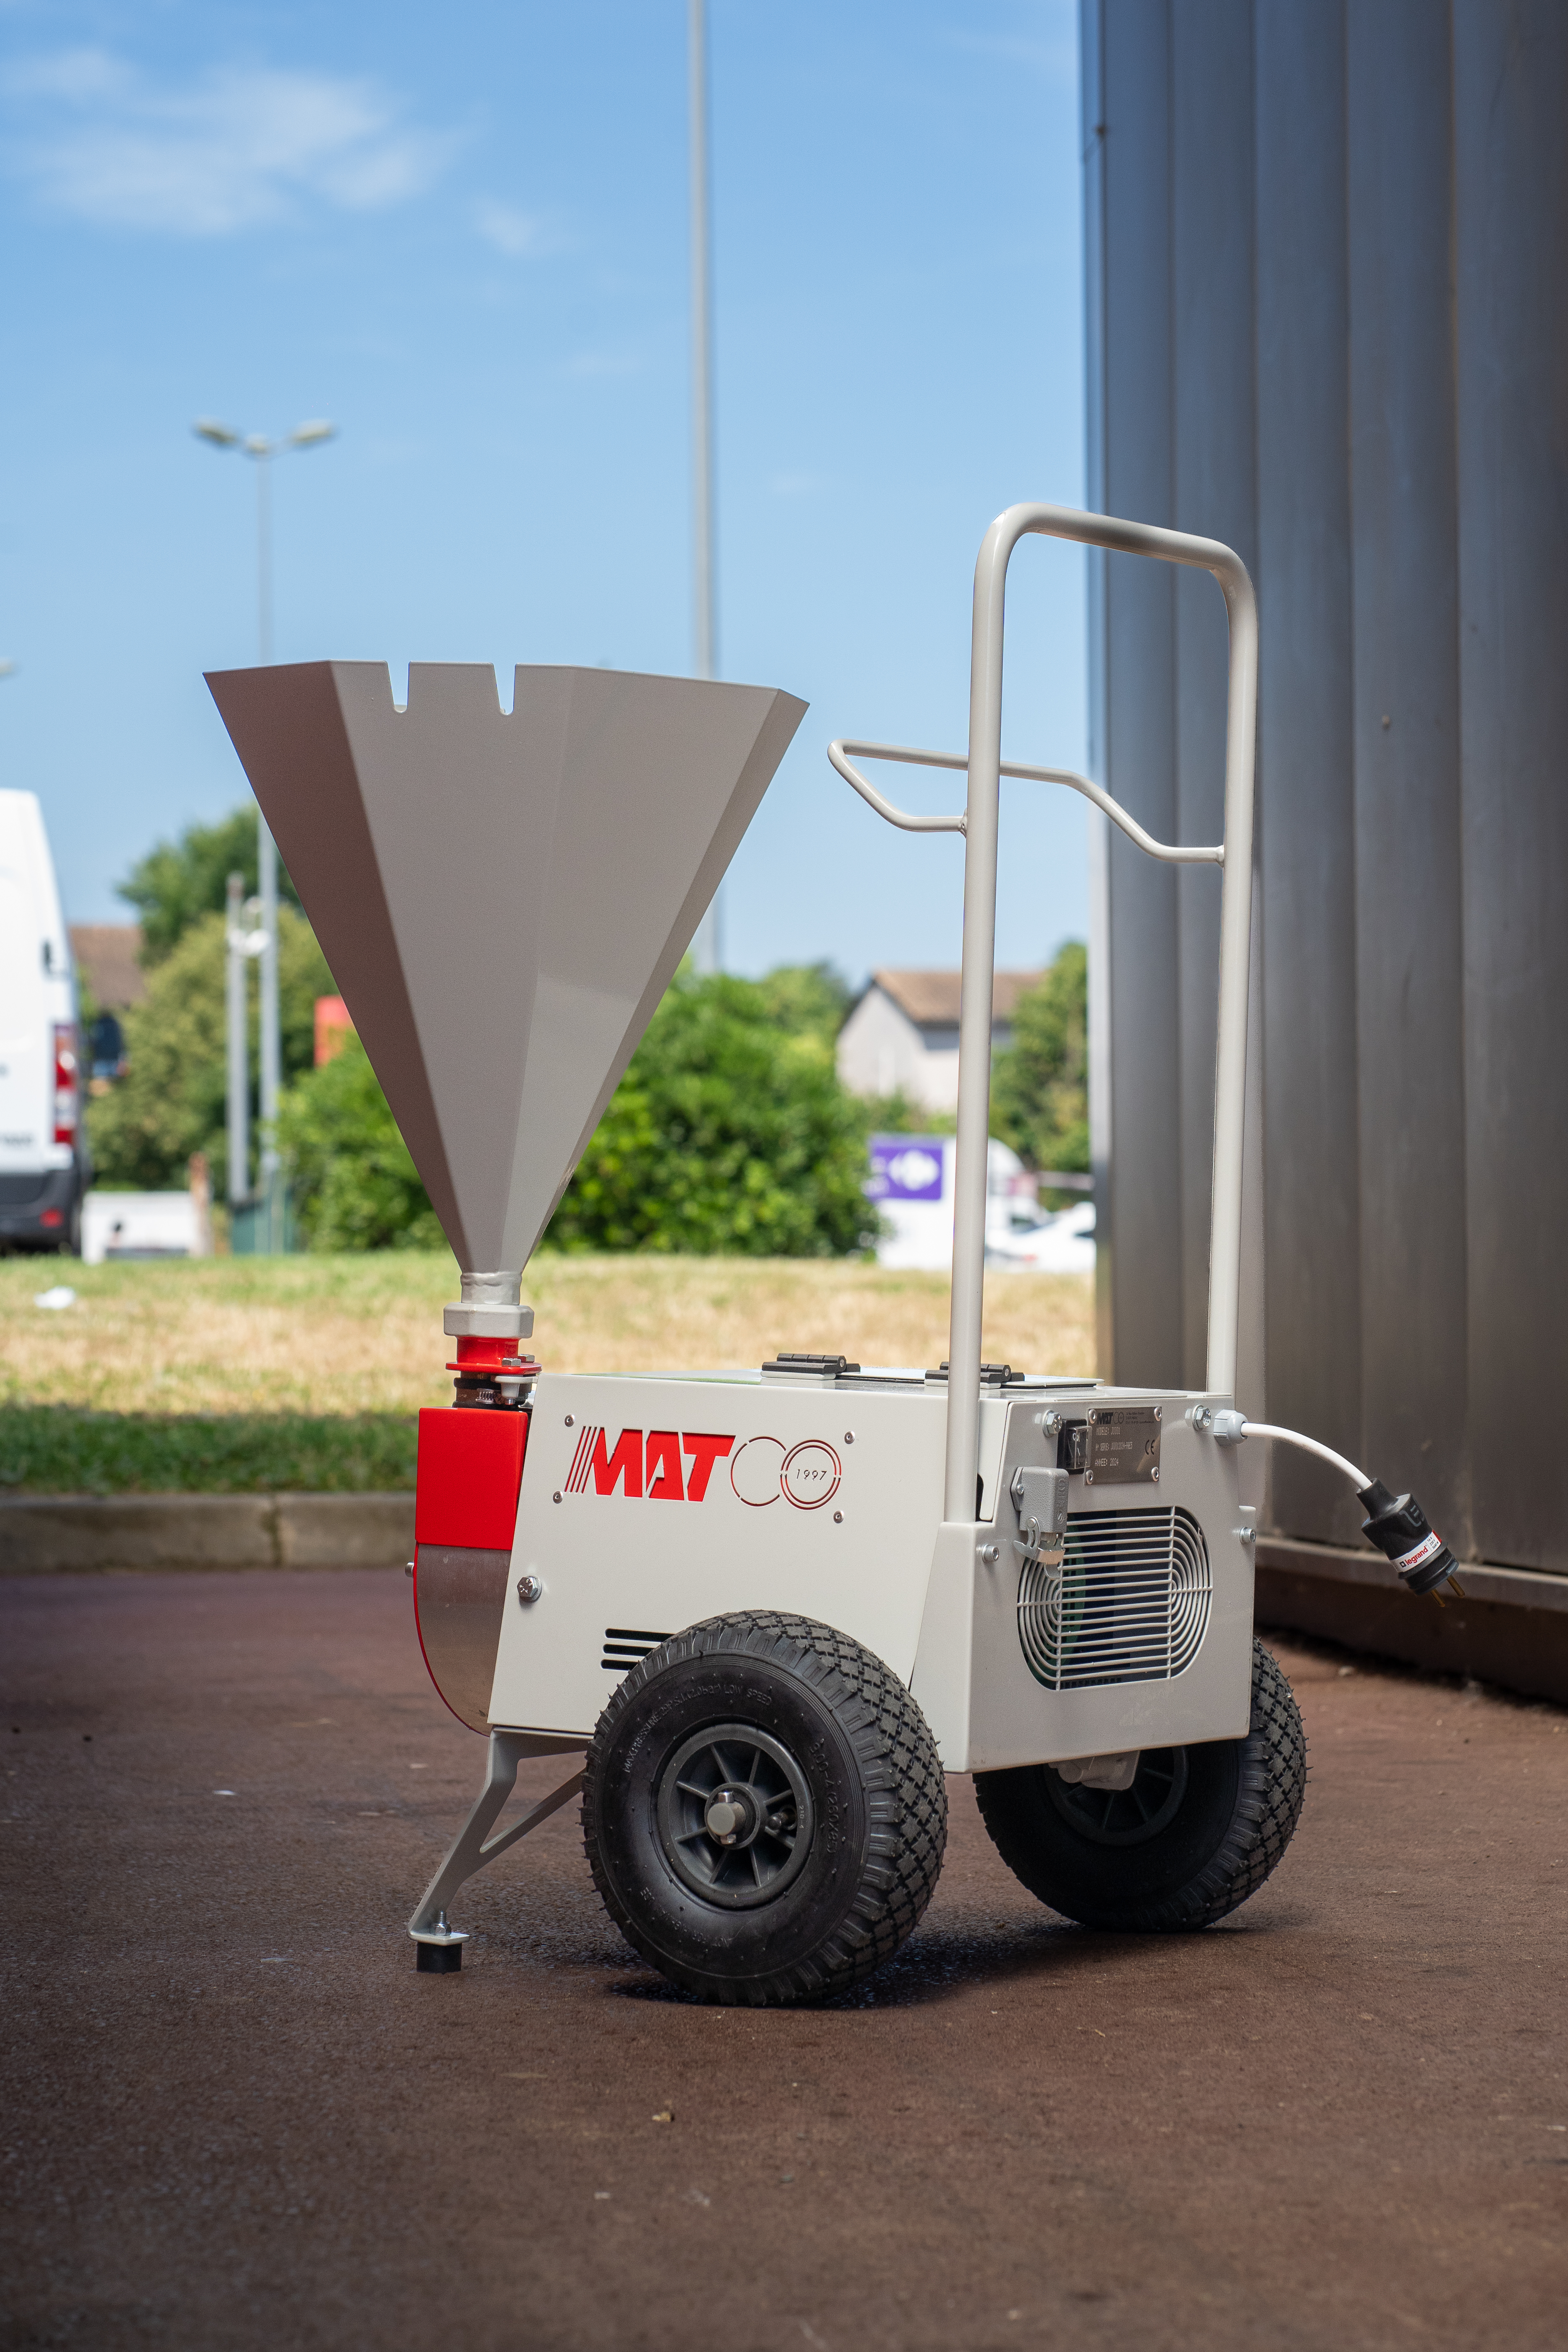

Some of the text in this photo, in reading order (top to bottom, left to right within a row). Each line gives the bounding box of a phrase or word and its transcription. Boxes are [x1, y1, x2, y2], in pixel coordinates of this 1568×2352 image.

[1110, 1458, 1119, 1466] 2024
[796, 1468, 827, 1482] 1997
[1404, 1546, 1428, 1565] legrand
[724, 1684, 744, 1695] LOW
[746, 1688, 772, 1706] SPEED
[809, 1742, 834, 1788] 3.00-4
[640, 1887, 655, 1905] USE
